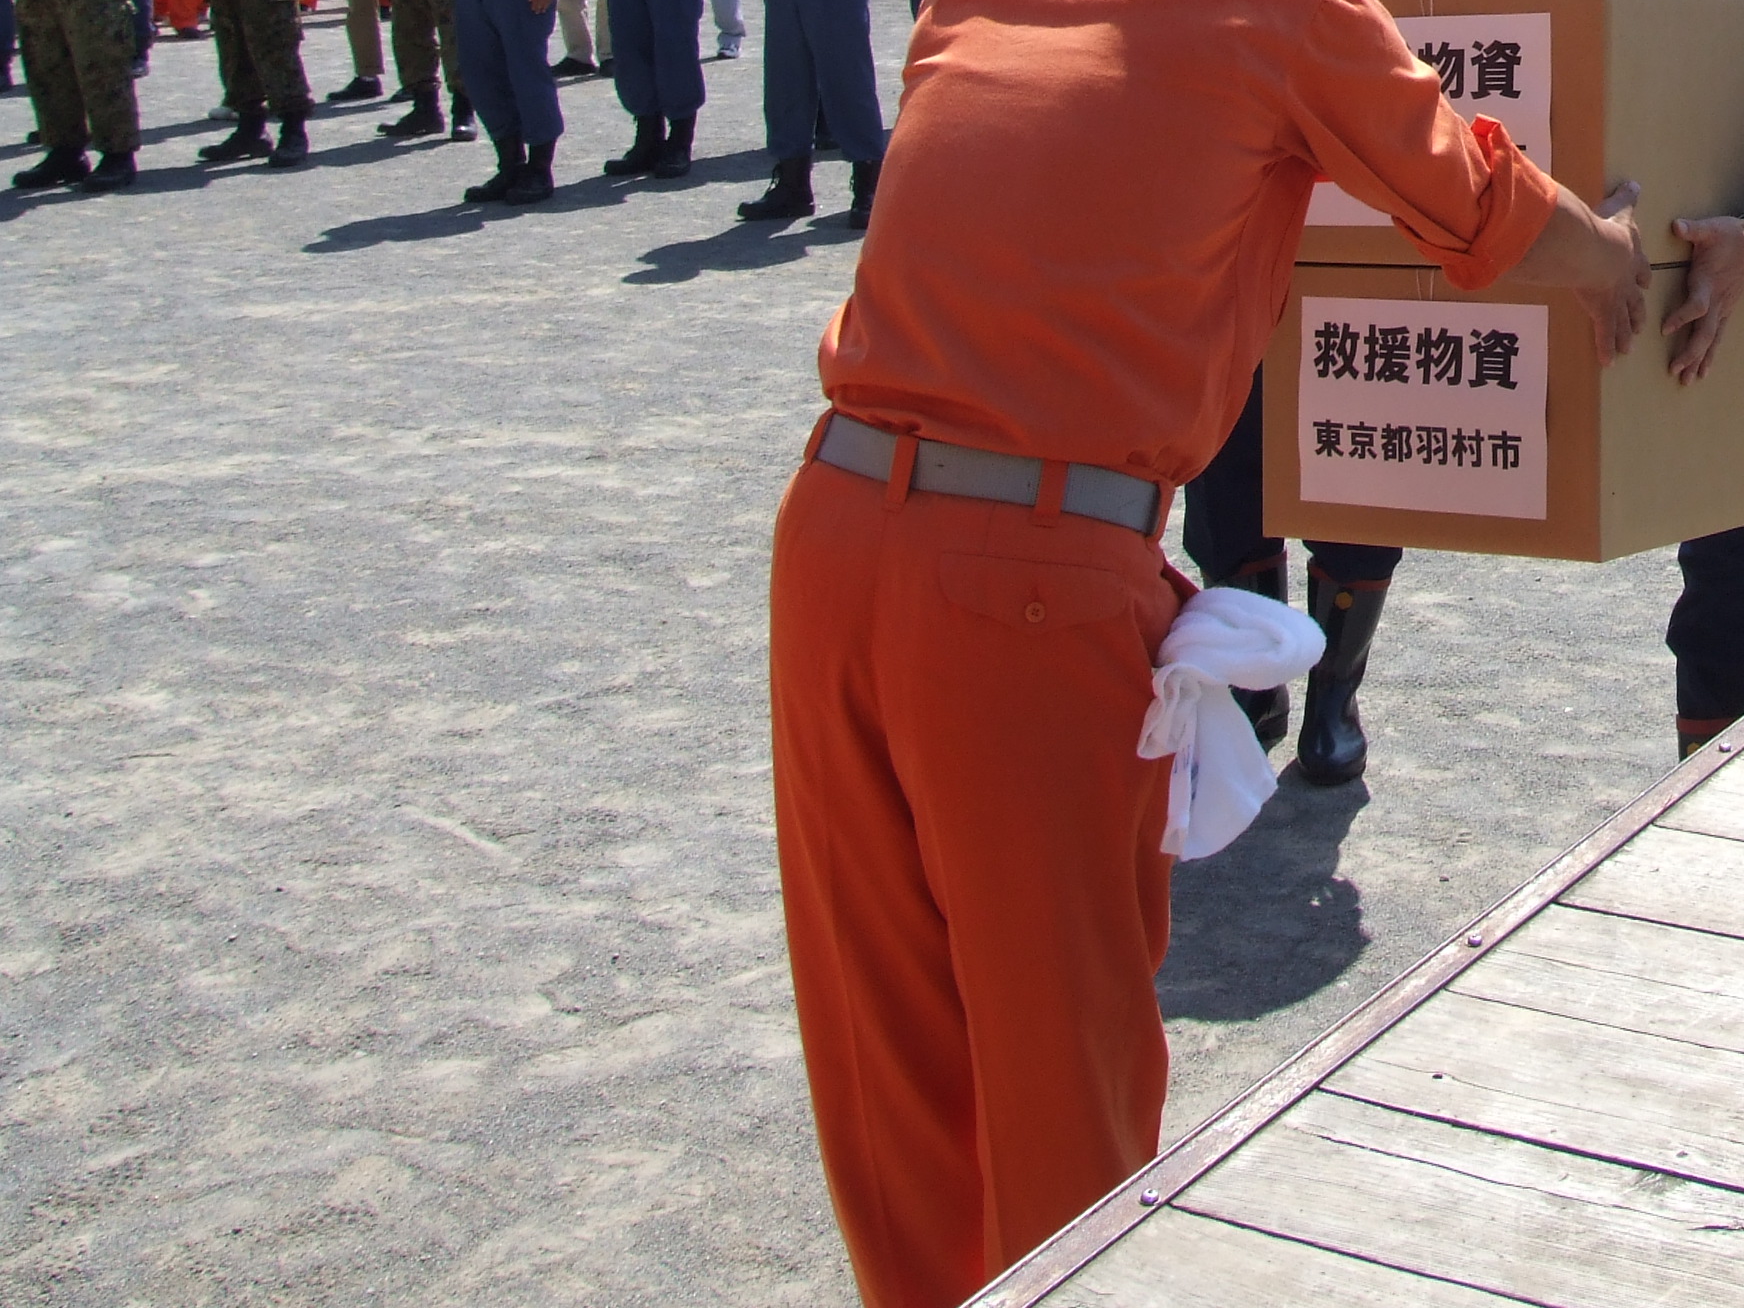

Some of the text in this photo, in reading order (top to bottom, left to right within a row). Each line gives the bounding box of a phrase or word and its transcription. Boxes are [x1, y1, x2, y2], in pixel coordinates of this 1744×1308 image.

[1406, 39, 1522, 100] 物資
[1313, 321, 1520, 391] 救援物資
[1312, 419, 1523, 470] 東京都羽村市
